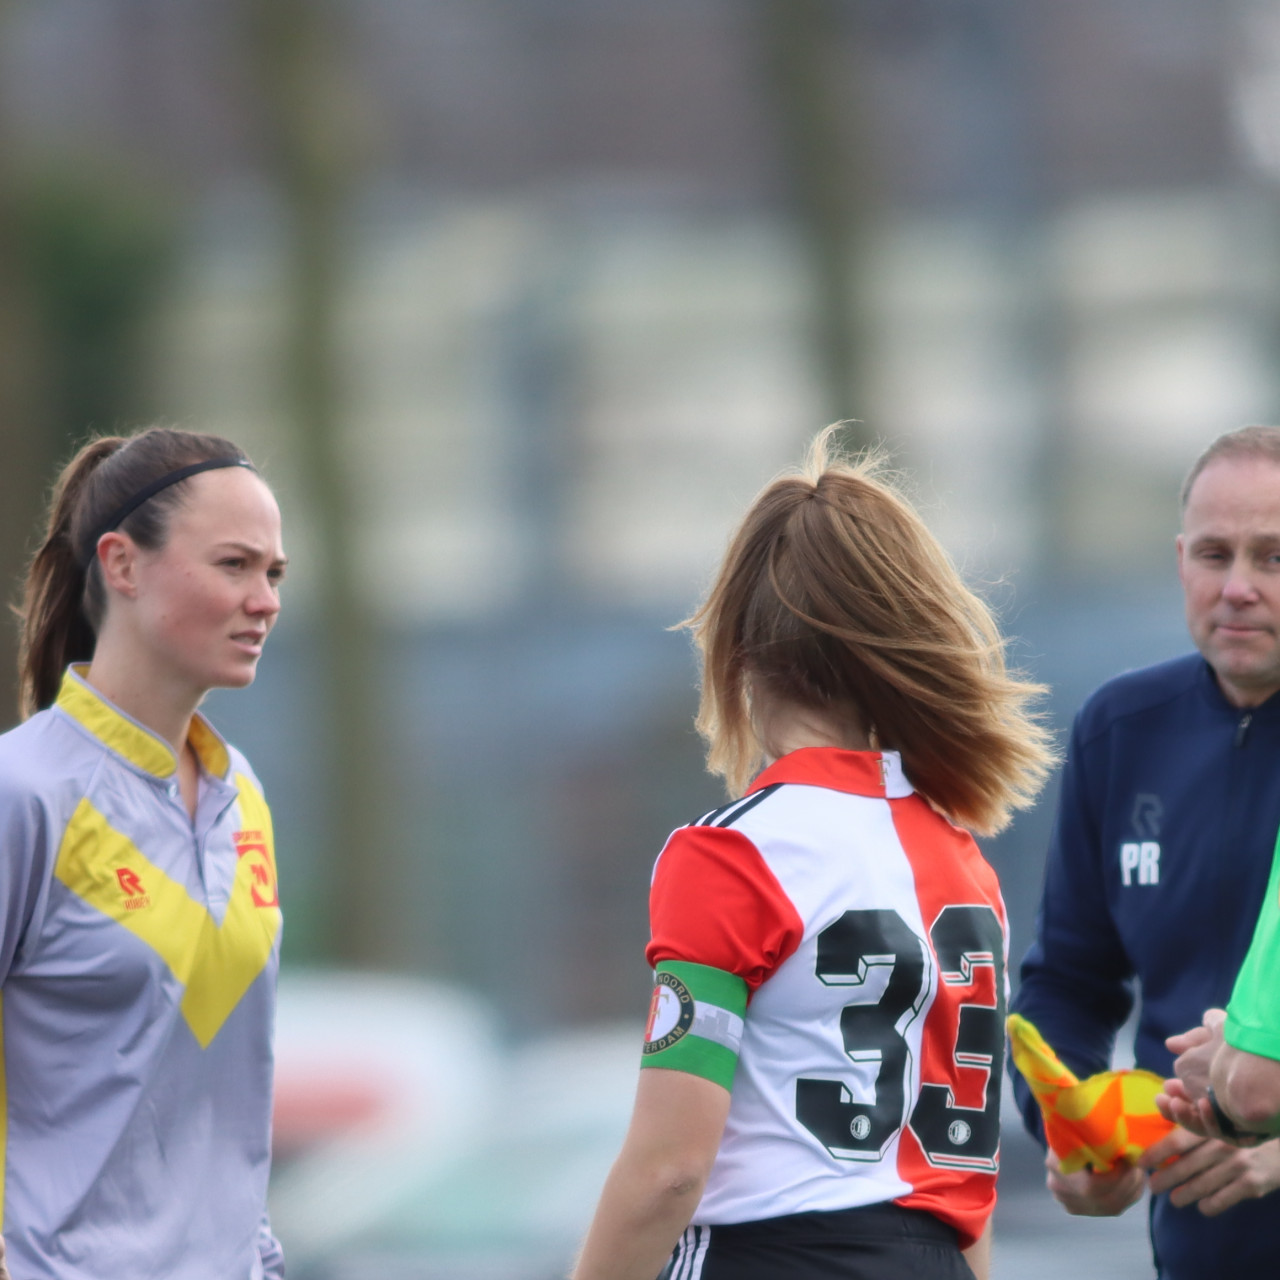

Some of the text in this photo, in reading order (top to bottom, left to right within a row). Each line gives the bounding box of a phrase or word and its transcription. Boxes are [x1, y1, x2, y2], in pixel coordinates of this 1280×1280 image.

[1121, 842, 1160, 885] PR
[658, 973, 690, 1004] NOORD
[645, 1025, 685, 1053] ERDAM
[795, 904, 1006, 1174] 33
